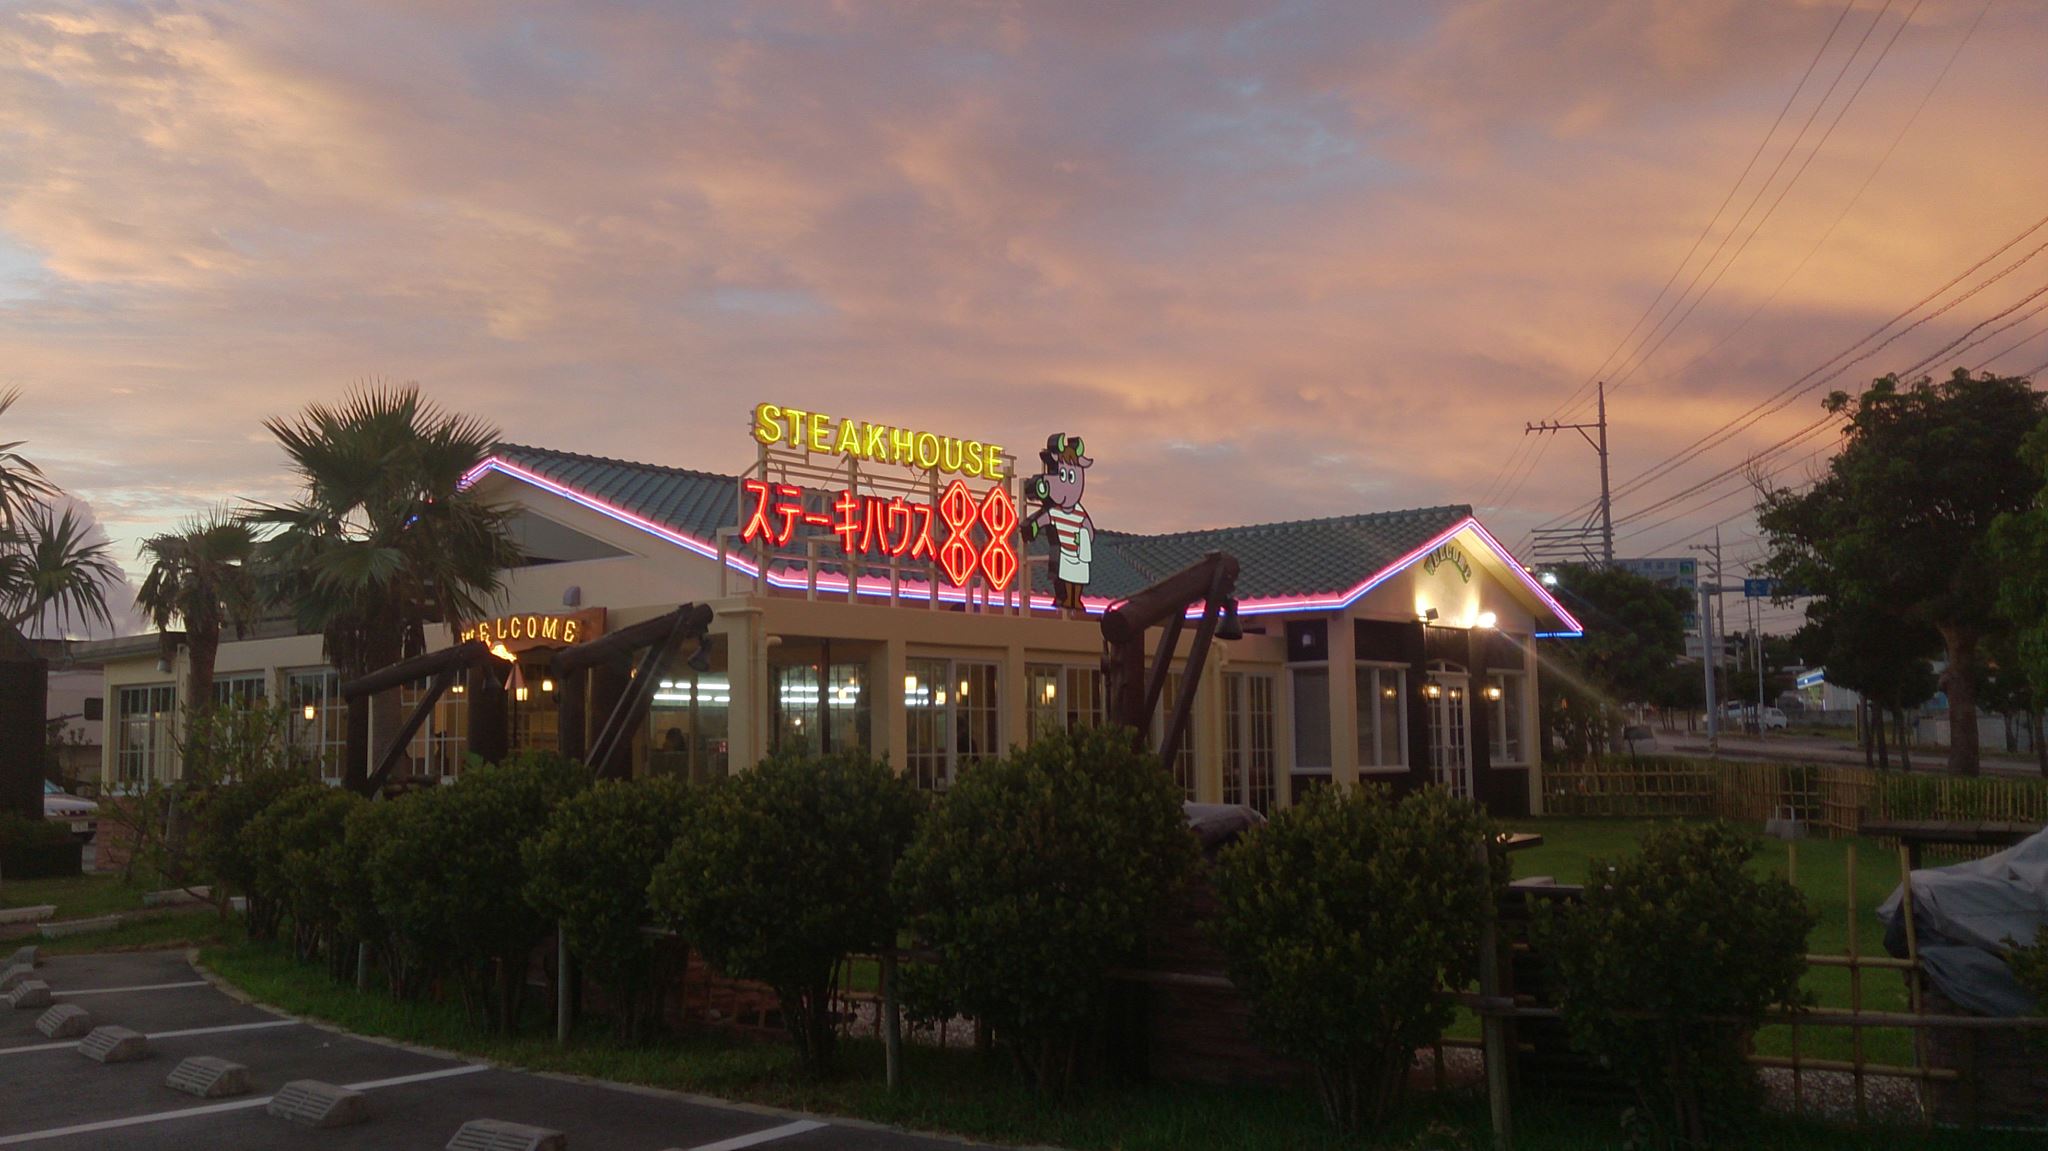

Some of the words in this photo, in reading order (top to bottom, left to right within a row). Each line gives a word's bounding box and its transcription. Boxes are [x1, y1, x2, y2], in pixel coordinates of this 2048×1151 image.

[755, 402, 1005, 480] STEAKHOUSE
[742, 479, 937, 561] ステーキハウス
[940, 478, 1018, 591] 88
